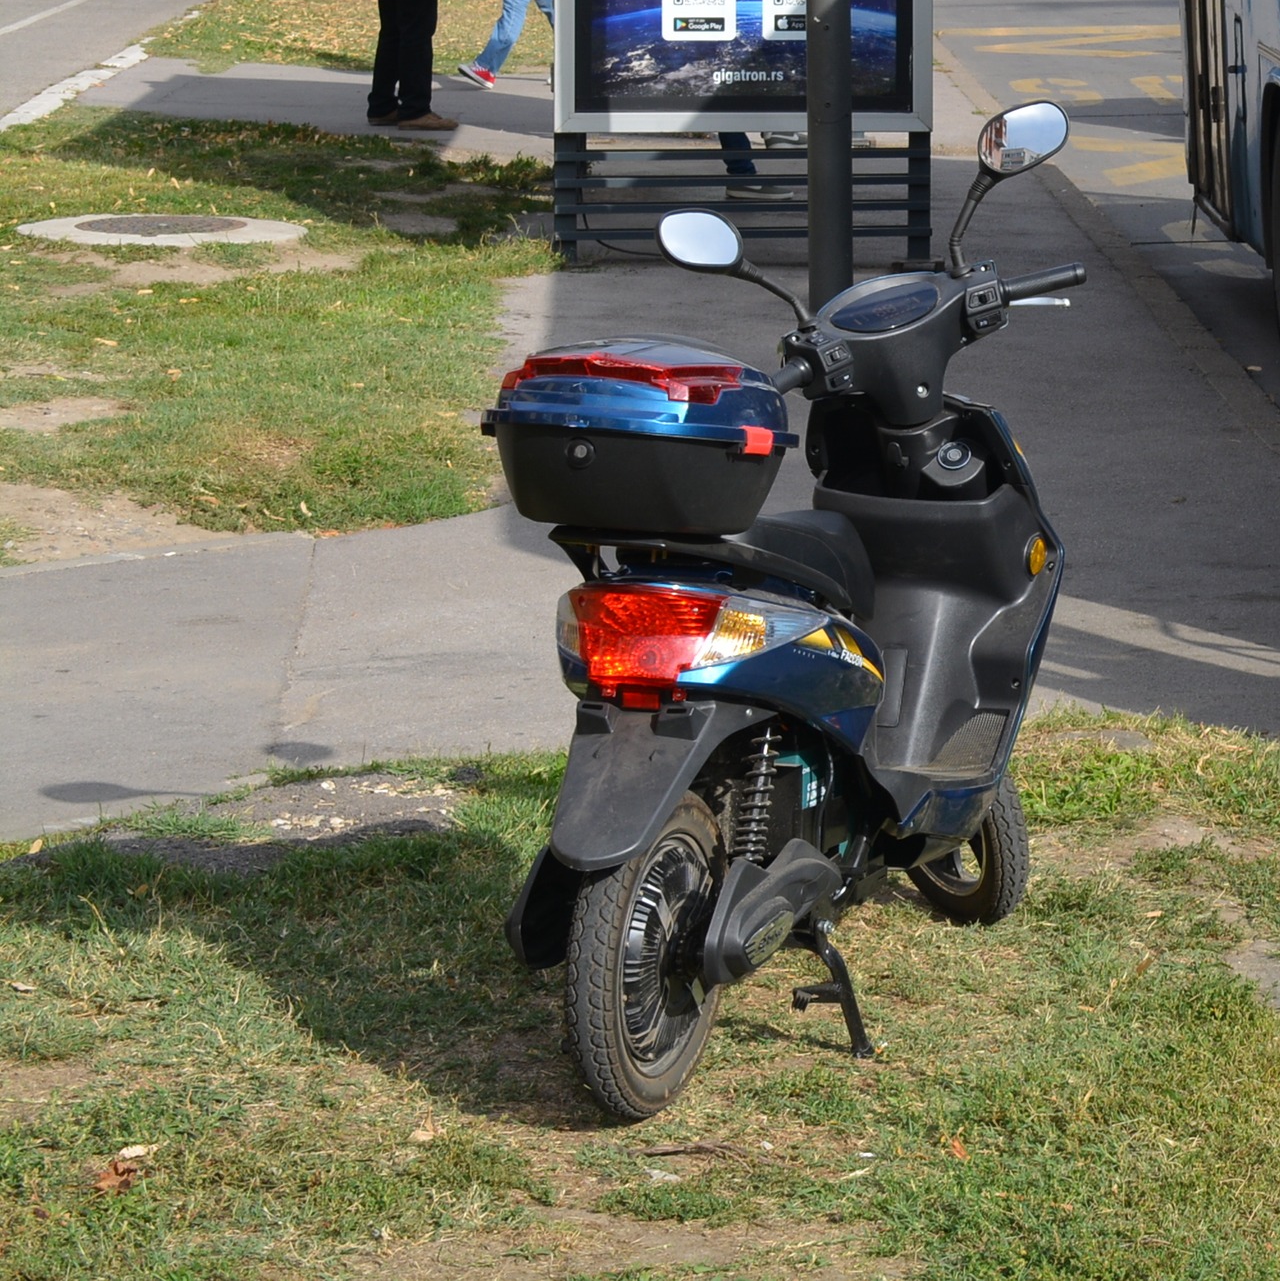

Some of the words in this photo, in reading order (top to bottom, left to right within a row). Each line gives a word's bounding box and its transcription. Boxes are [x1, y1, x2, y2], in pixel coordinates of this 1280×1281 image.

[688, 22, 709, 31] Google
[709, 22, 723, 31] Play
[791, 21, 804, 29] App
[712, 67, 785, 85] gigatron.rs
